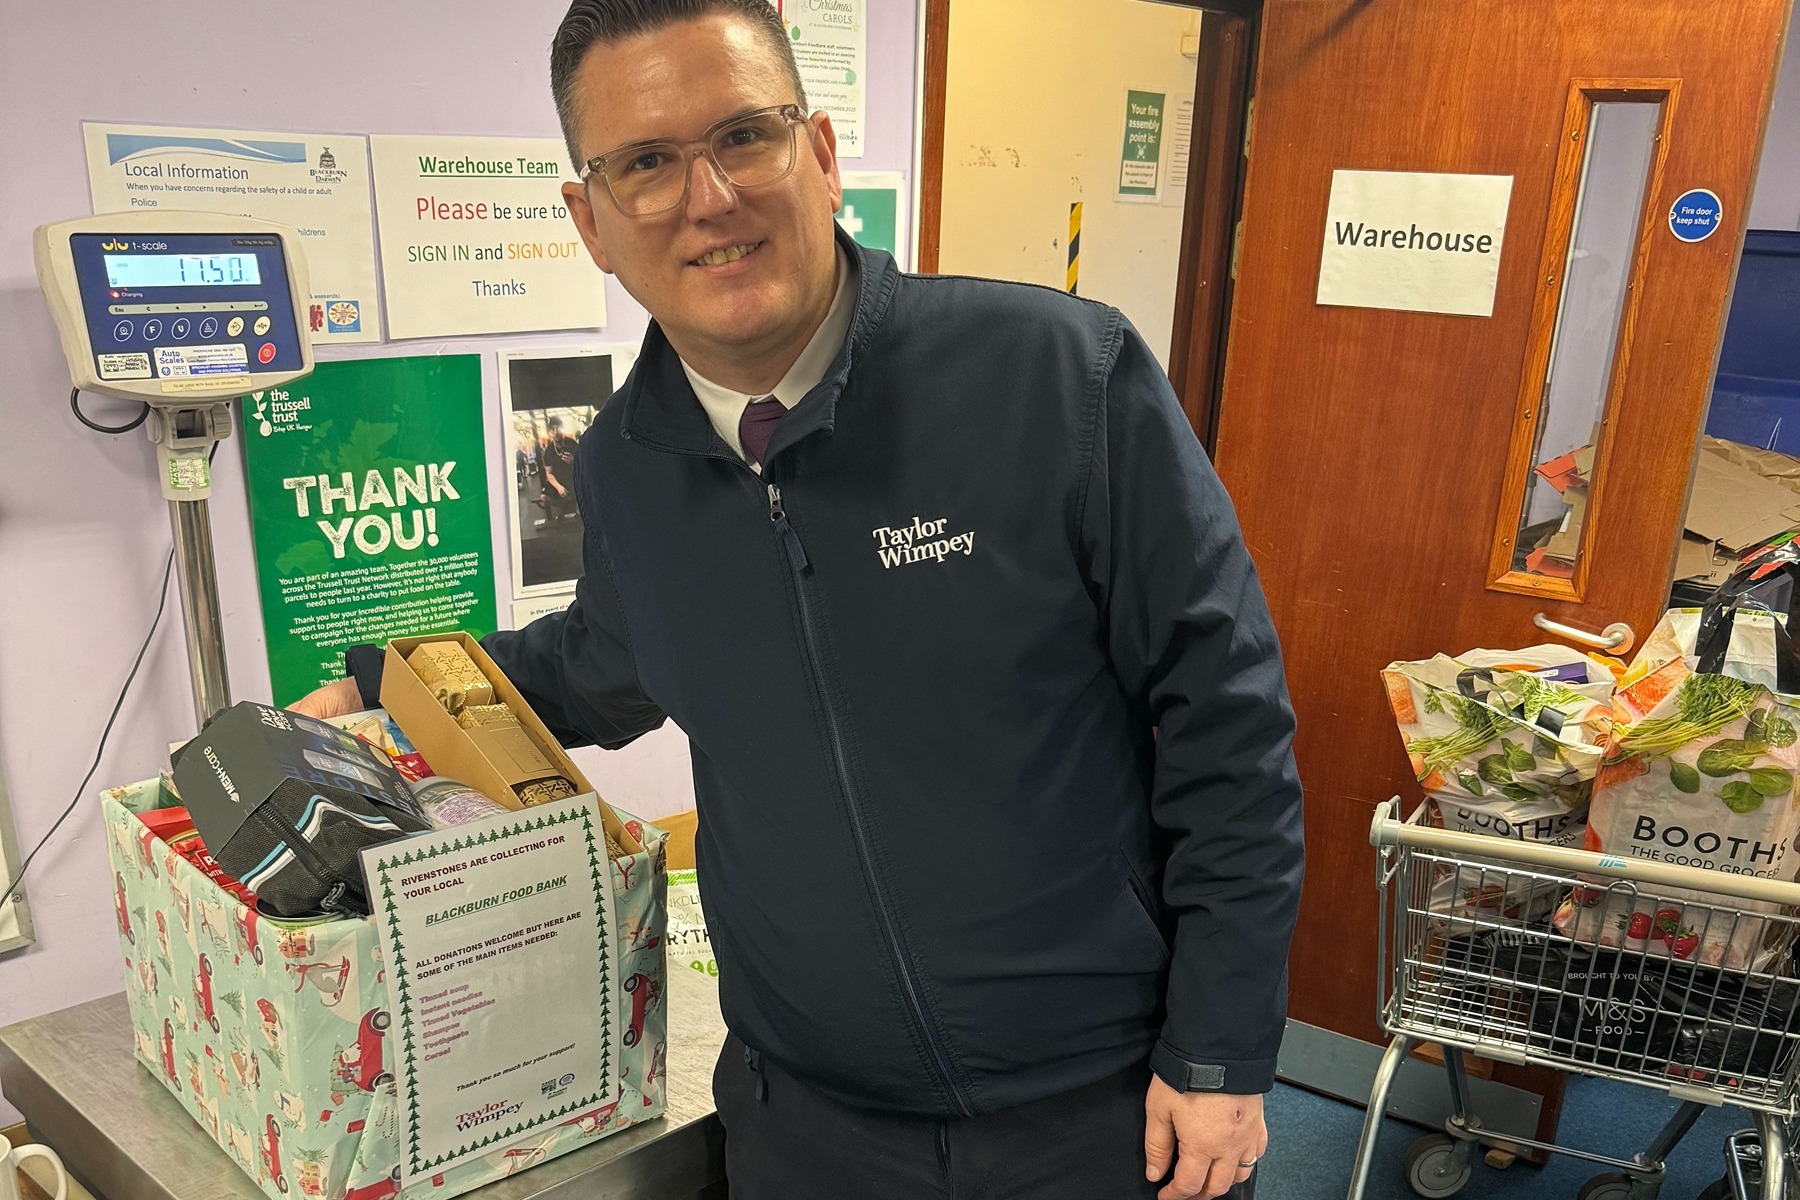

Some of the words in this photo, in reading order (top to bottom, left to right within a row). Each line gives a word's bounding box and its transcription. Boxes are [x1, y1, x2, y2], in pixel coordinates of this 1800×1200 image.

[823, 13, 853, 25] CAROLS
[1131, 103, 1147, 116] Your
[1148, 105, 1159, 117] fire
[1128, 119, 1160, 133] assembly
[1129, 132, 1148, 144] point
[125, 162, 163, 177] Local
[168, 163, 249, 180] Information
[419, 156, 513, 174] Warehouse
[517, 158, 559, 175] Team
[126, 183, 148, 191] When
[165, 184, 182, 192] have
[184, 185, 215, 193] concerns
[216, 186, 247, 195] regarding
[247, 186, 259, 194] the
[259, 187, 278, 195] safety
[131, 198, 158, 207] Police
[416, 196, 488, 221] Please
[493, 203, 512, 220] be
[516, 207, 548, 220] sure
[552, 206, 567, 219] to
[1681, 207, 1695, 215] Fire
[1676, 217, 1693, 225] keep
[1694, 217, 1710, 225] shut
[298, 228, 326, 237] hildrens
[1334, 220, 1493, 255] Warehouse
[132, 241, 168, 251] t-scale
[408, 245, 447, 262] SIGN
[453, 244, 470, 261] IN
[475, 243, 503, 260] and
[507, 243, 543, 260] SIGN
[548, 242, 578, 259] OUT
[121, 291, 143, 299] Charging
[472, 279, 527, 297] Thanks
[159, 356, 185, 365] Scales
[161, 350, 181, 358] Auto
[270, 389, 290, 402] the
[271, 397, 311, 413] trussell
[272, 410, 299, 423] trust
[283, 461, 461, 518] THANK
[317, 508, 439, 559] YOU!
[872, 516, 948, 549] Taylor
[877, 531, 975, 569] Wimpey
[282, 586, 304, 594] across
[317, 579, 343, 589] Trussell
[344, 577, 361, 585] Trust
[362, 574, 389, 583] Network
[390, 567, 424, 579] distributed
[444, 562, 464, 571] million
[465, 559, 478, 568] food
[307, 575, 321, 583] part
[322, 572, 329, 580] of
[341, 567, 369, 578] amazing
[370, 565, 389, 574] team.
[389, 562, 417, 571] Together
[430, 557, 449, 566] 30,000
[449, 552, 479, 562] volunteers
[285, 593, 309, 604] parcels
[319, 588, 342, 598] people
[343, 586, 356, 594] last
[357, 585, 372, 594] year.
[204, 746, 237, 795] MEN+care
[1632, 815, 1788, 865] BOOTHS
[401, 862, 468, 887] RIVENSTONES
[470, 857, 489, 869] ARE
[490, 840, 546, 862] COLLECTING
[547, 835, 566, 847] FOR
[1630, 845, 1661, 861] THE
[1664, 853, 1715, 870] GOOD
[404, 886, 431, 900] YOUR
[433, 877, 465, 892] LOCAL
[425, 895, 500, 926] BLACKBURN
[502, 885, 534, 903] FOOD
[536, 875, 568, 894] BANK
[415, 959, 433, 969] ALL
[434, 942, 484, 964] DONATIONS
[484, 929, 525, 948] WELCOME
[526, 924, 543, 935] BUT
[544, 917, 565, 930] HERE
[566, 911, 582, 923] ARE
[417, 968, 442, 981] SOME
[444, 964, 456, 973] OF
[457, 959, 474, 969] THE
[475, 950, 497, 964] MAIN
[499, 942, 524, 955] ITEMS
[525, 931, 558, 948] NEEDED:
[419, 989, 448, 1004] Tinned
[450, 983, 470, 995] soup
[420, 999, 451, 1017] Instant
[452, 990, 483, 1006] noodles
[421, 1013, 450, 1028] Tinned
[451, 998, 496, 1018] Vegetables
[1579, 997, 1646, 1023] M&S
[422, 1022, 461, 1040] Shampoo
[423, 1029, 470, 1052] Toothpaste
[1595, 1026, 1632, 1036] FOOD
[424, 1047, 451, 1062] Cereal
[456, 1079, 478, 1092] Thank
[479, 1075, 492, 1086] you
[493, 1071, 502, 1079] so
[502, 1063, 522, 1076] much
[522, 1059, 533, 1068] for
[533, 1054, 549, 1066] your
[549, 1042, 576, 1060] support!
[455, 1099, 509, 1124] Taylor
[455, 1101, 524, 1133] Wimpey
